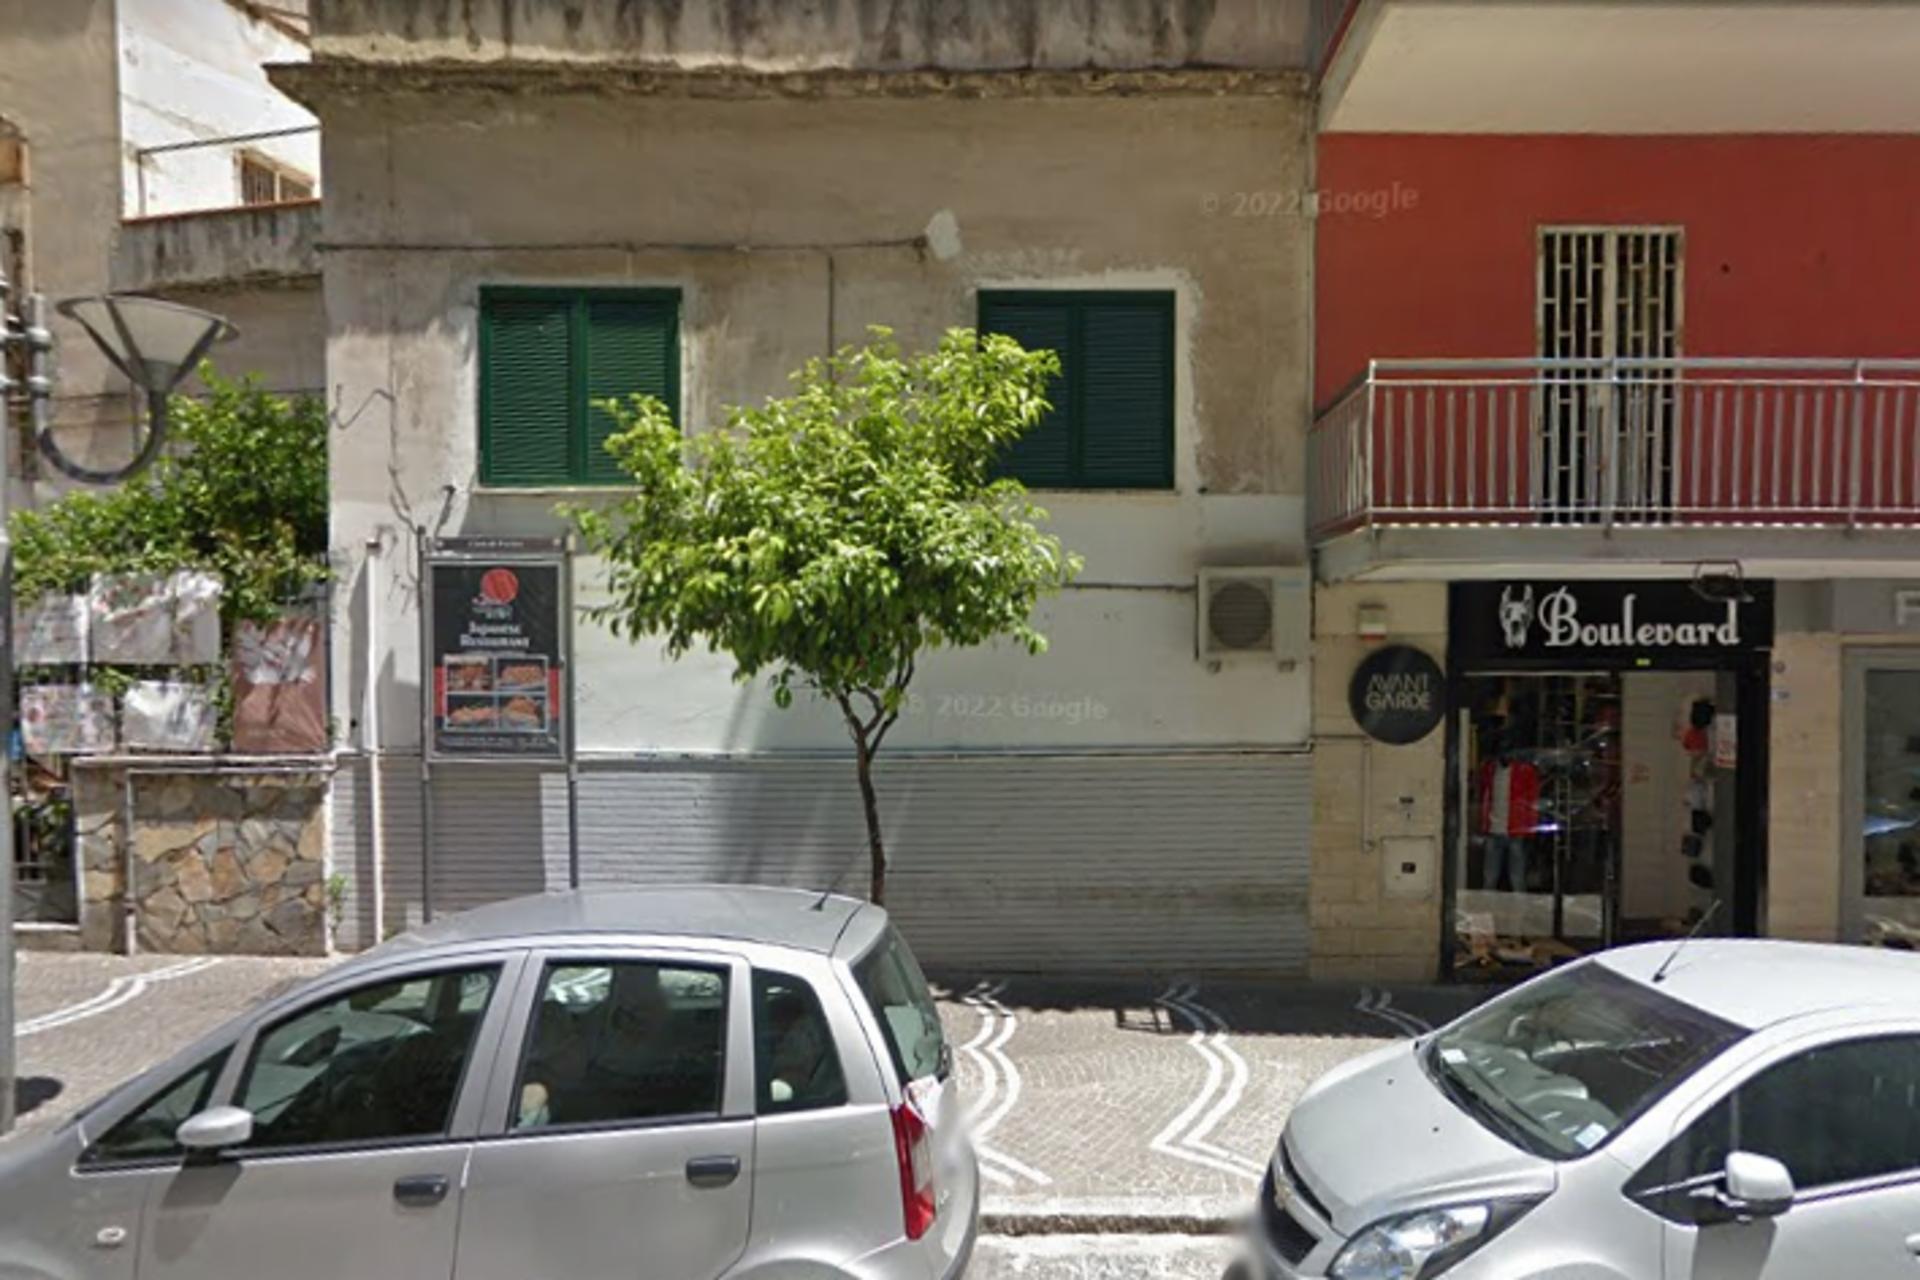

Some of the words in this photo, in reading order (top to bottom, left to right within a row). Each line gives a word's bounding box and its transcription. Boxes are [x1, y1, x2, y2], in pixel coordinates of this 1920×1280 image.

[1538, 584, 1741, 648] Boulevard
[1366, 672, 1430, 690] AVANT
[1365, 690, 1432, 711] GARDE
